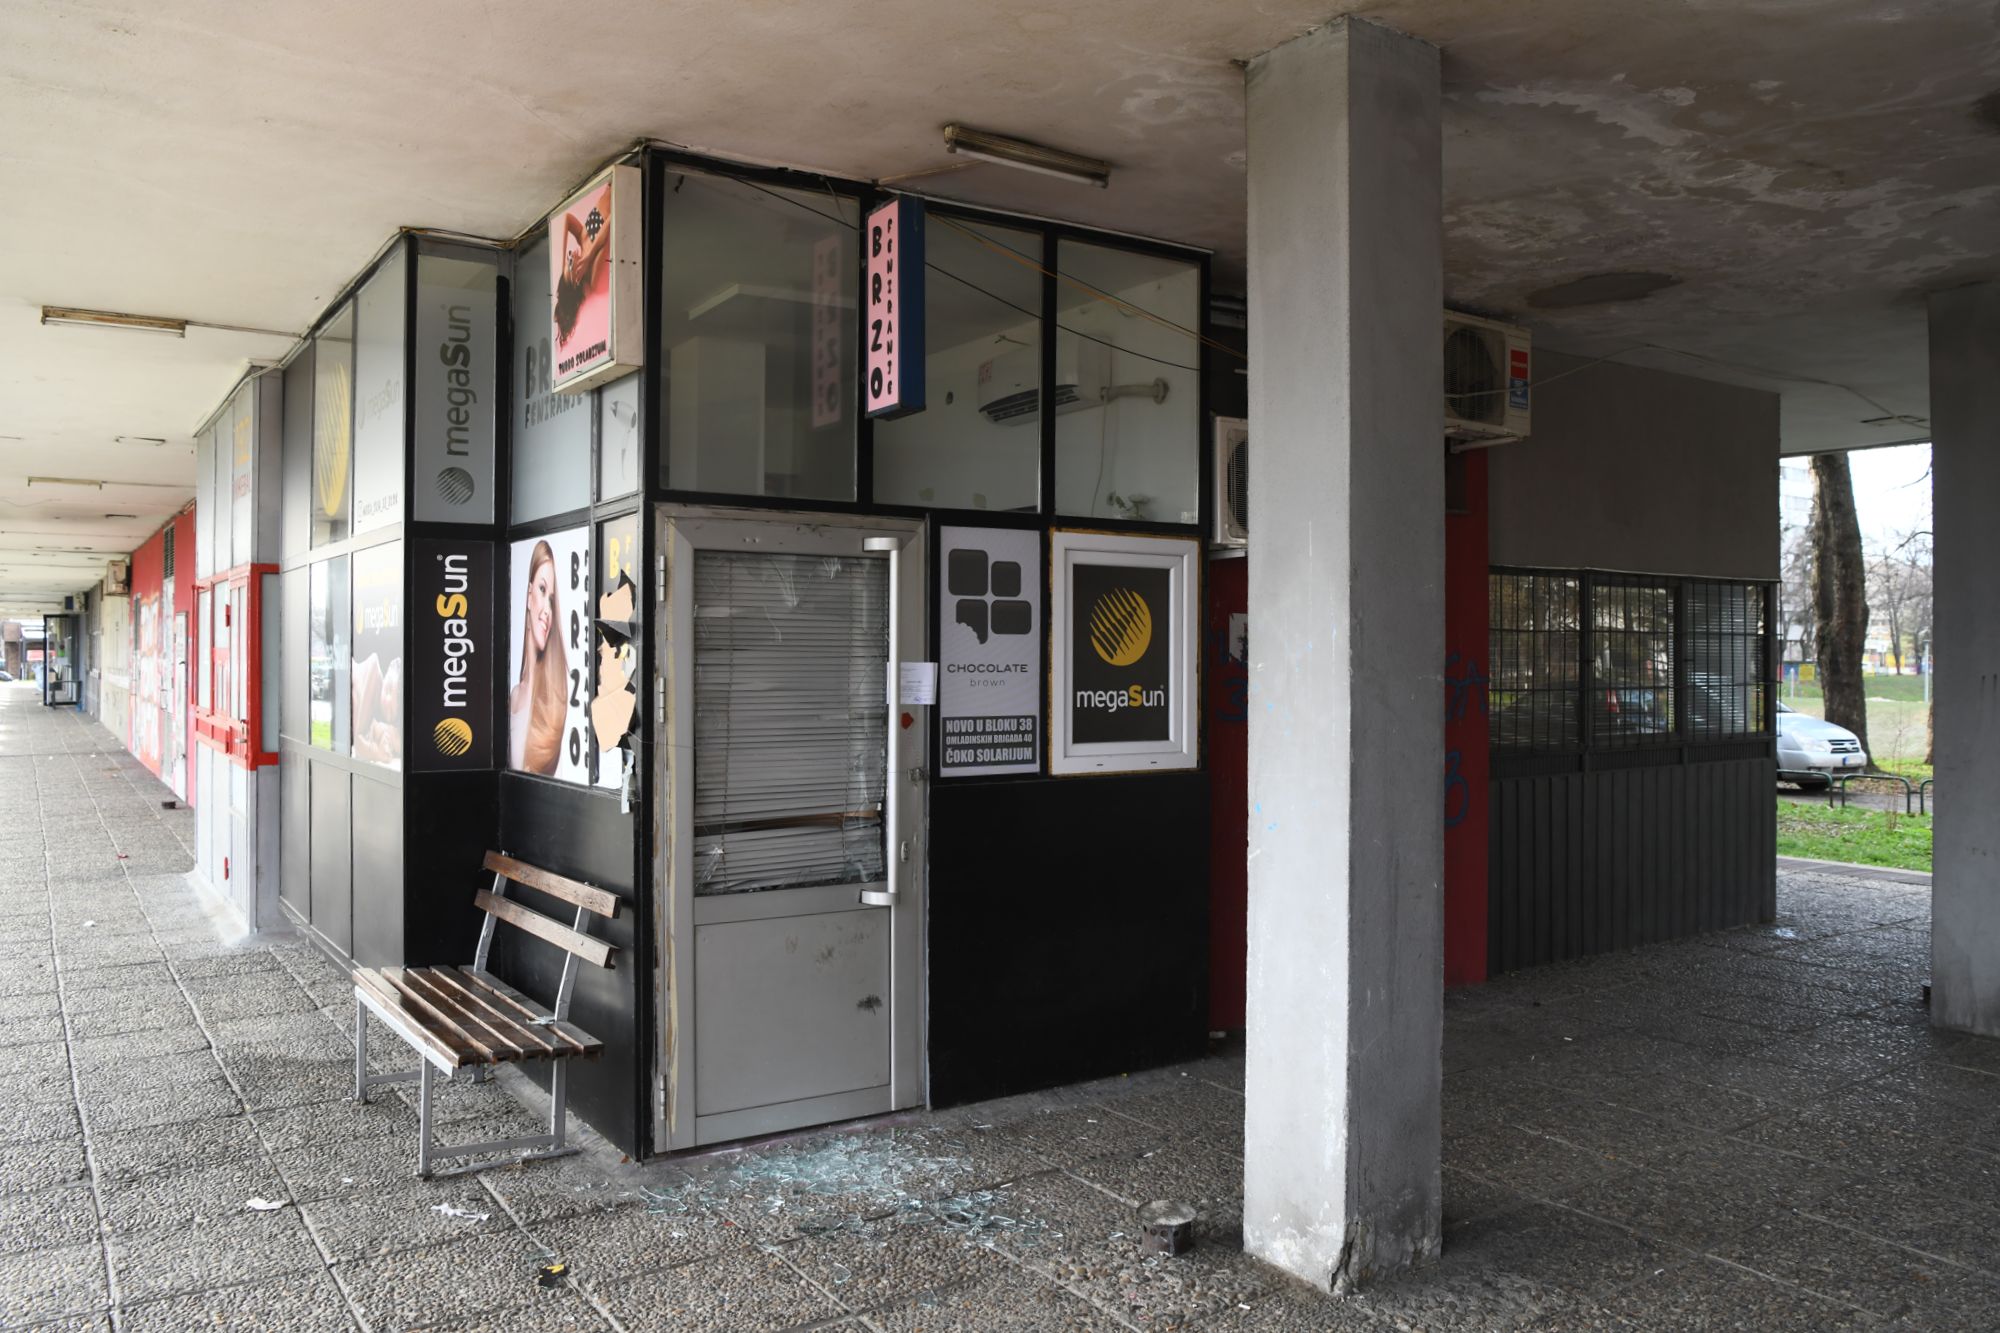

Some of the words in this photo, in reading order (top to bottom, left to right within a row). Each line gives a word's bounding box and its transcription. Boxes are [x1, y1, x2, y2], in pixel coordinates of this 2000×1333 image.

[870, 225, 883, 399] BRZO
[440, 305, 478, 456] megaSun
[525, 338, 552, 400] BR
[436, 554, 475, 708] megaSun
[570, 551, 580, 767] BRZO
[946, 663, 1029, 673] CHOCOLATE
[969, 679, 1006, 688] brown
[1076, 684, 1165, 713] megaSun
[945, 719, 974, 733] NOVO
[976, 719, 984, 733] U
[985, 718, 1017, 732] BLOKU
[1019, 718, 1033, 731] 38
[945, 735, 993, 746] OMLADINSKIH
[994, 734, 1023, 744] BRIGADA
[1024, 733, 1033, 743] 40
[945, 747, 975, 764] ČOKO
[976, 747, 1033, 762] SOLARIJUM
